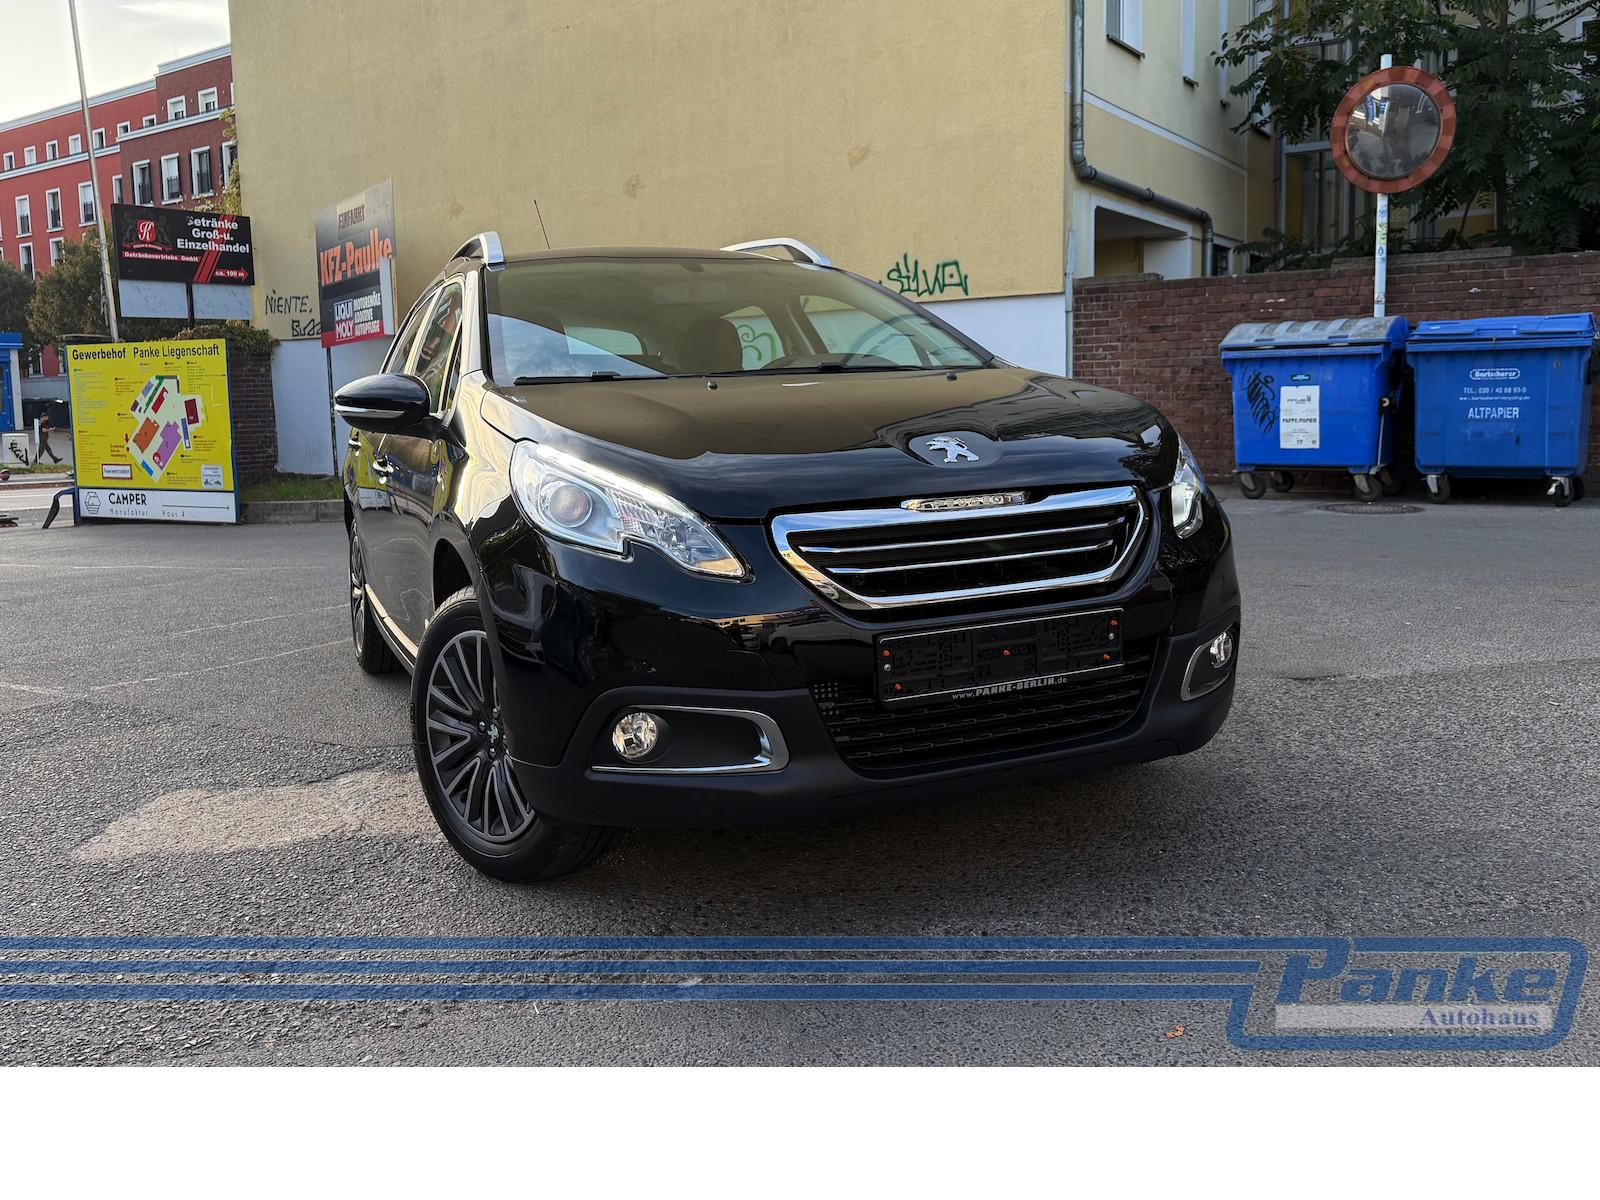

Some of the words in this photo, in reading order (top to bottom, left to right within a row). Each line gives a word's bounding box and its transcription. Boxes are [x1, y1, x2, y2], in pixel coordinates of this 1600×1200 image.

[176, 238, 250, 253] Einzelhandel
[319, 226, 392, 288] KFZ-Paulke
[335, 300, 353, 321] LIQUI
[336, 319, 354, 339] MOLY
[72, 347, 126, 360] Gewerbehof
[133, 346, 160, 359] Panke
[162, 343, 220, 360] Liegenschaft
[1467, 406, 1520, 419] ALTPAPIER
[108, 492, 147, 506] CAMPER
[109, 508, 149, 517] Manufaktur
